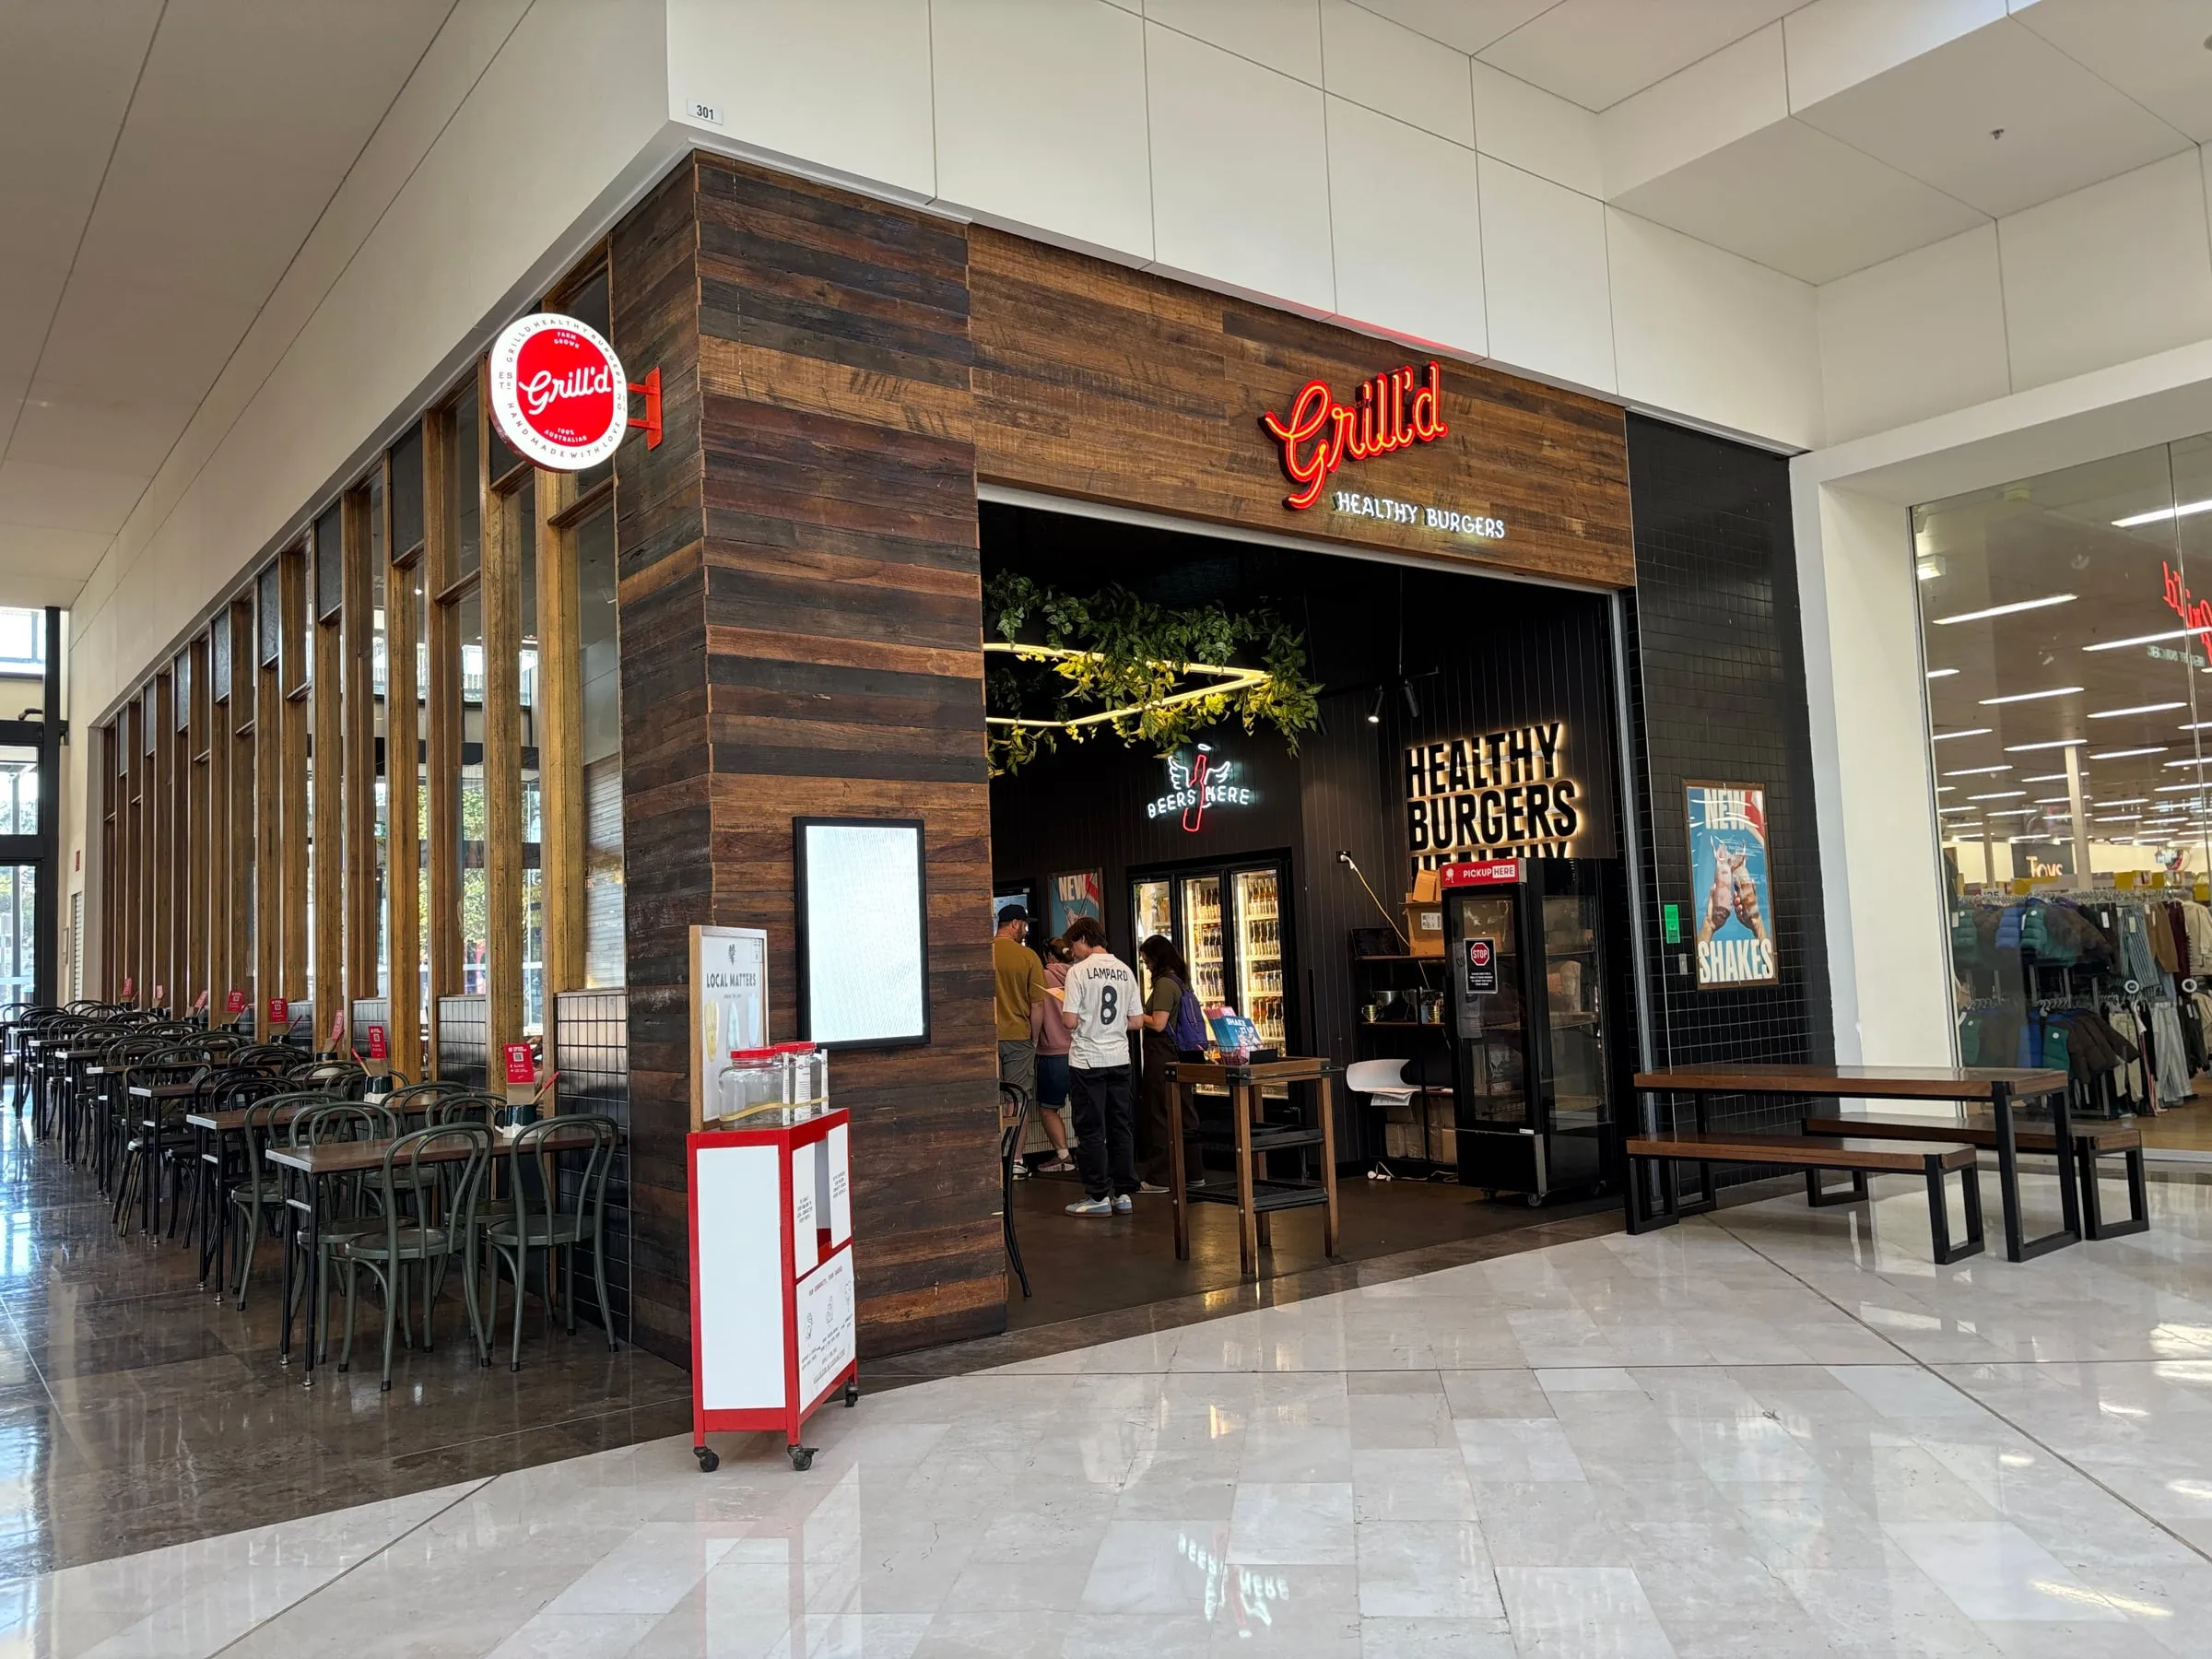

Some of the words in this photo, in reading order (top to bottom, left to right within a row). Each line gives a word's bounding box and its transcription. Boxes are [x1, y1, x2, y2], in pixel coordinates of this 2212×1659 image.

[696, 104, 714, 121] 301
[534, 319, 588, 333] HEALTHY
[557, 331, 576, 341] FARM
[553, 338, 580, 349] GROWN
[518, 365, 612, 415] Grill'd
[507, 402, 529, 435] HAND
[531, 437, 565, 458] MADE
[570, 446, 600, 458] WITH
[544, 429, 588, 443] AUSTRALIAN
[1259, 360, 1449, 510] Grill'd
[1335, 490, 1418, 524] HEALTHY
[1426, 508, 1506, 538] BURGERS
[1404, 723, 1560, 798] HEALTHY
[1147, 789, 1196, 818] BEERS
[1206, 785, 1250, 805] HERE
[1406, 780, 1578, 852] BURGERS
[1704, 788, 1747, 830] NEW
[1463, 867, 1492, 878] PICKUP
[1493, 866, 1514, 876] HERE
[1058, 874, 1087, 901] NEW
[1472, 949, 1488, 959] STOP
[1697, 938, 1774, 984] SHAKES
[706, 972, 728, 988] LOCAL
[729, 972, 757, 988] MATTERS
[1087, 967, 1128, 982] LAMPARD
[1100, 985, 1117, 1025] 8
